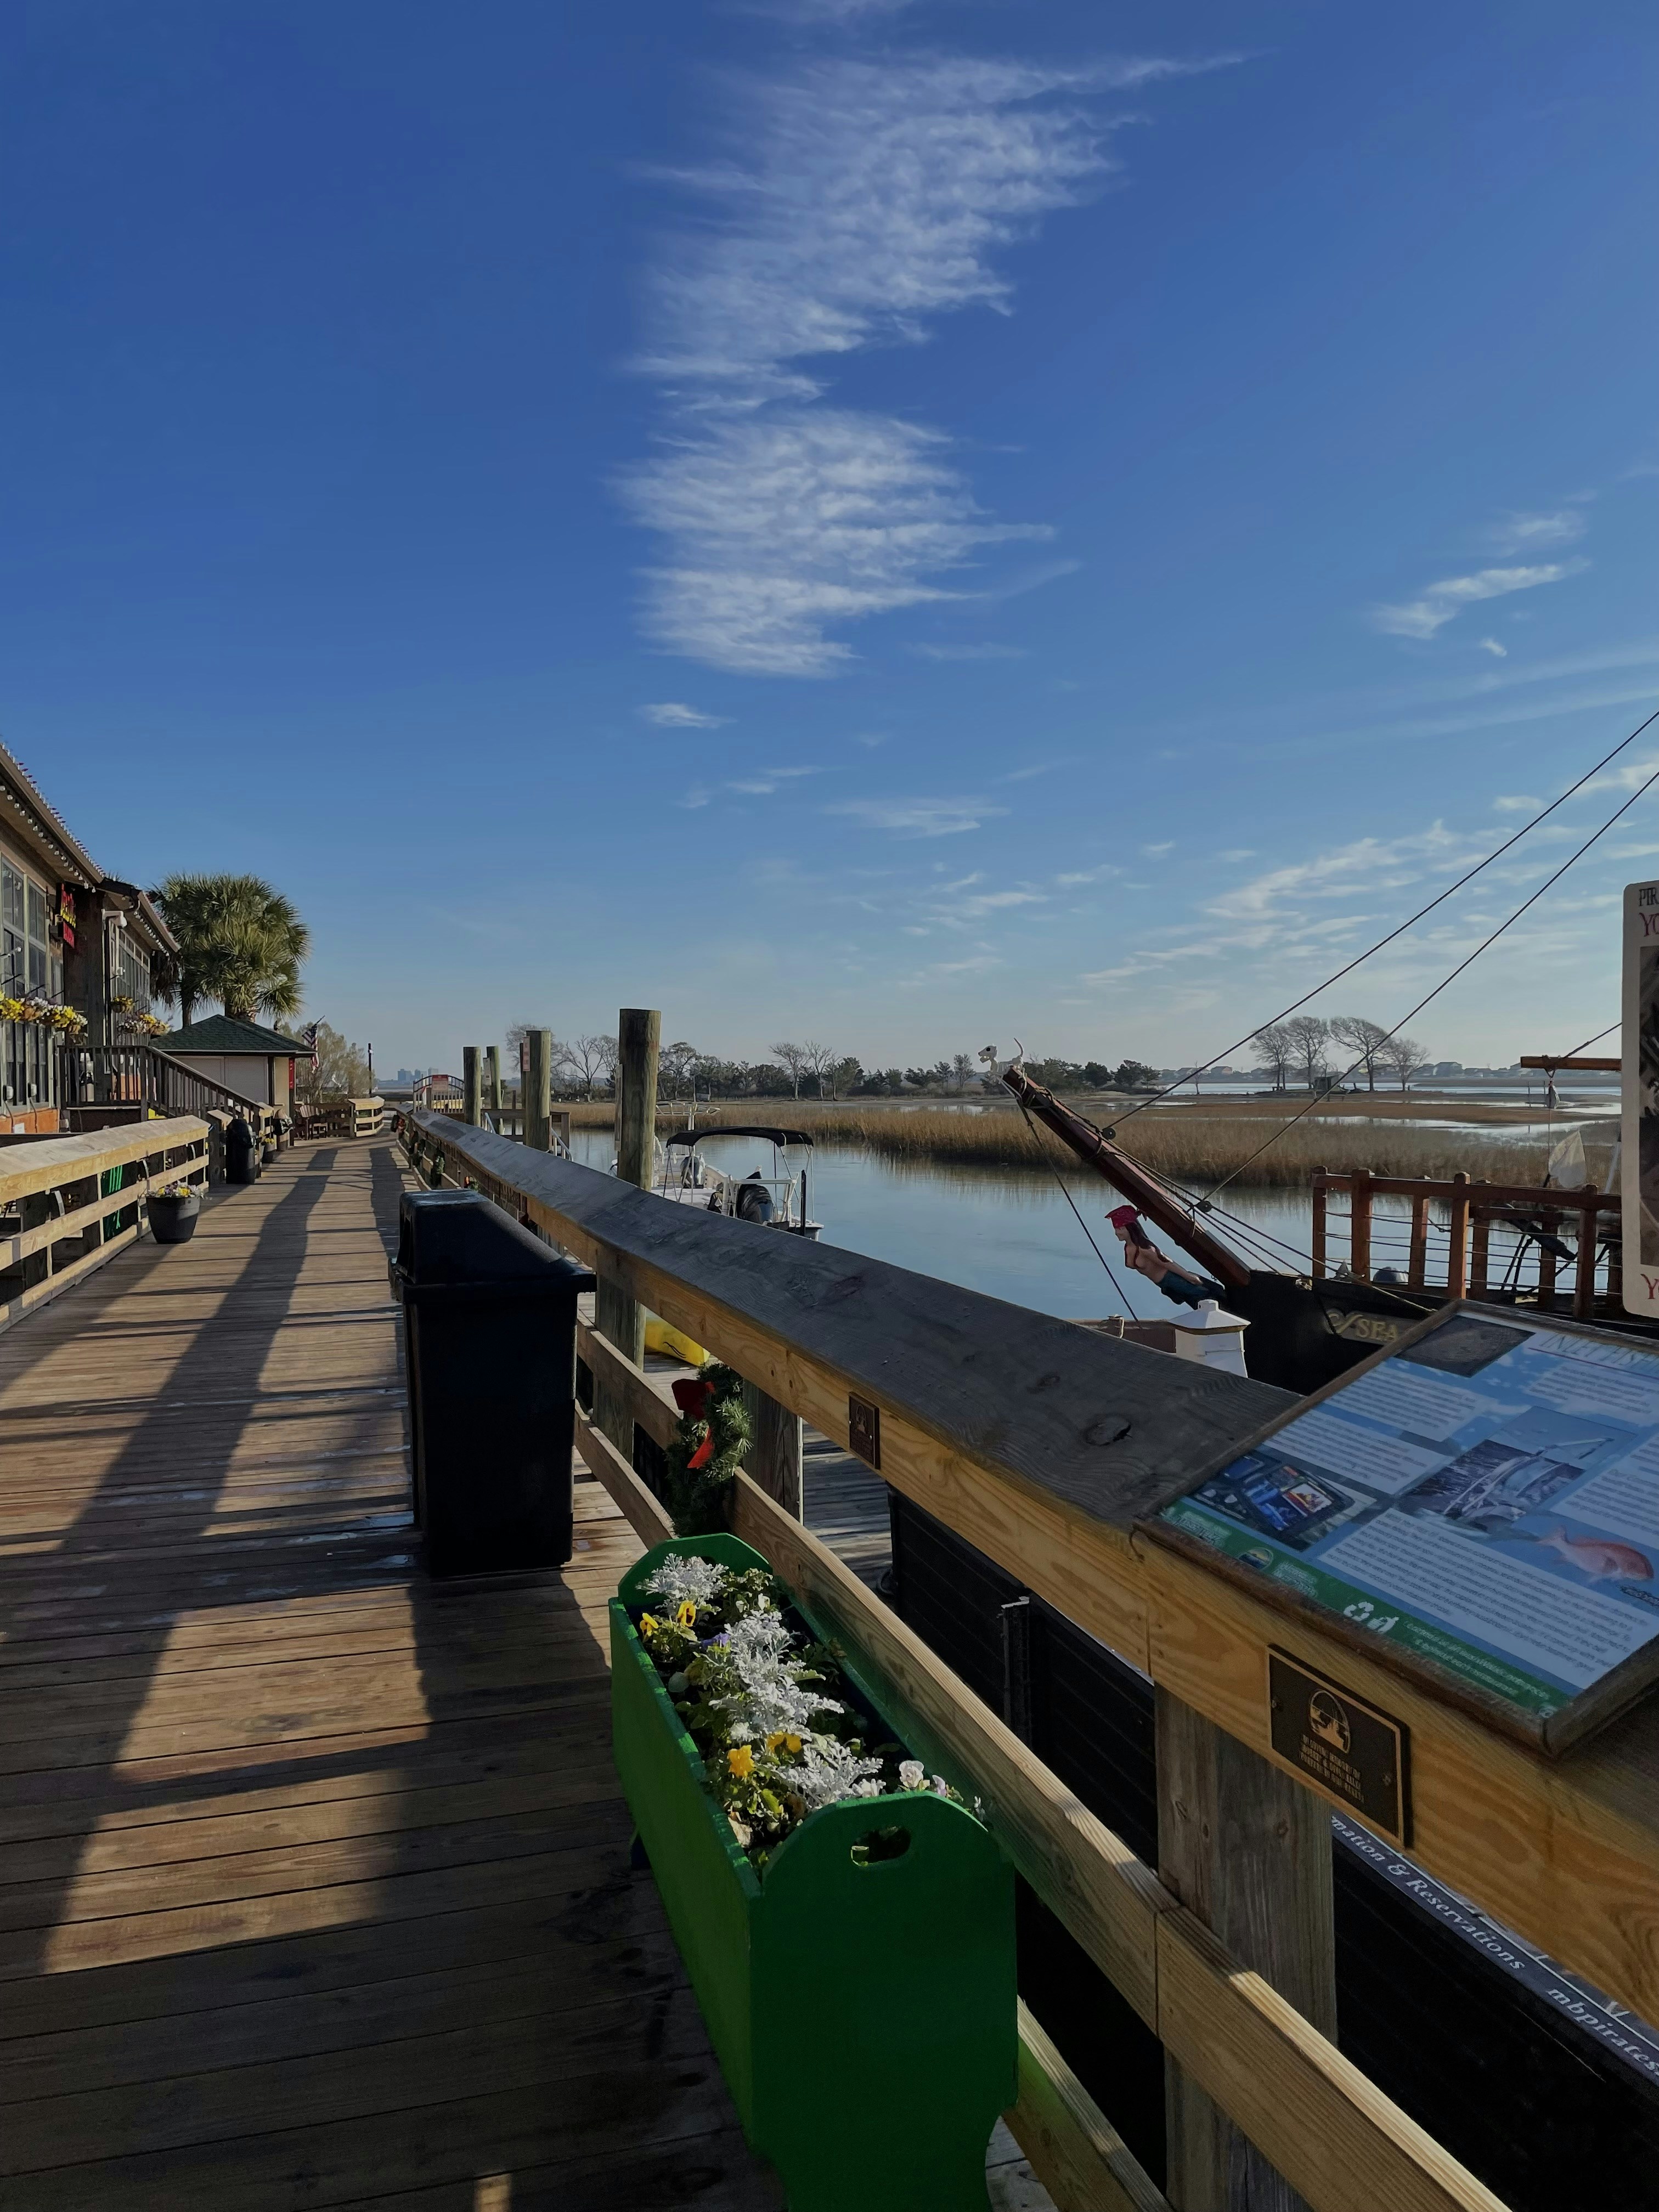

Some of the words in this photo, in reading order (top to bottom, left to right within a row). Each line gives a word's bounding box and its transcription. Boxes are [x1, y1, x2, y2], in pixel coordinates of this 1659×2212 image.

[1640, 1273, 1659, 1300] Y
[1331, 1816, 1385, 1861] mation
[1387, 1864, 1410, 1875] &
[1406, 1880, 1525, 1970] Reservations
[1547, 1989, 1659, 2076] mbpirates
